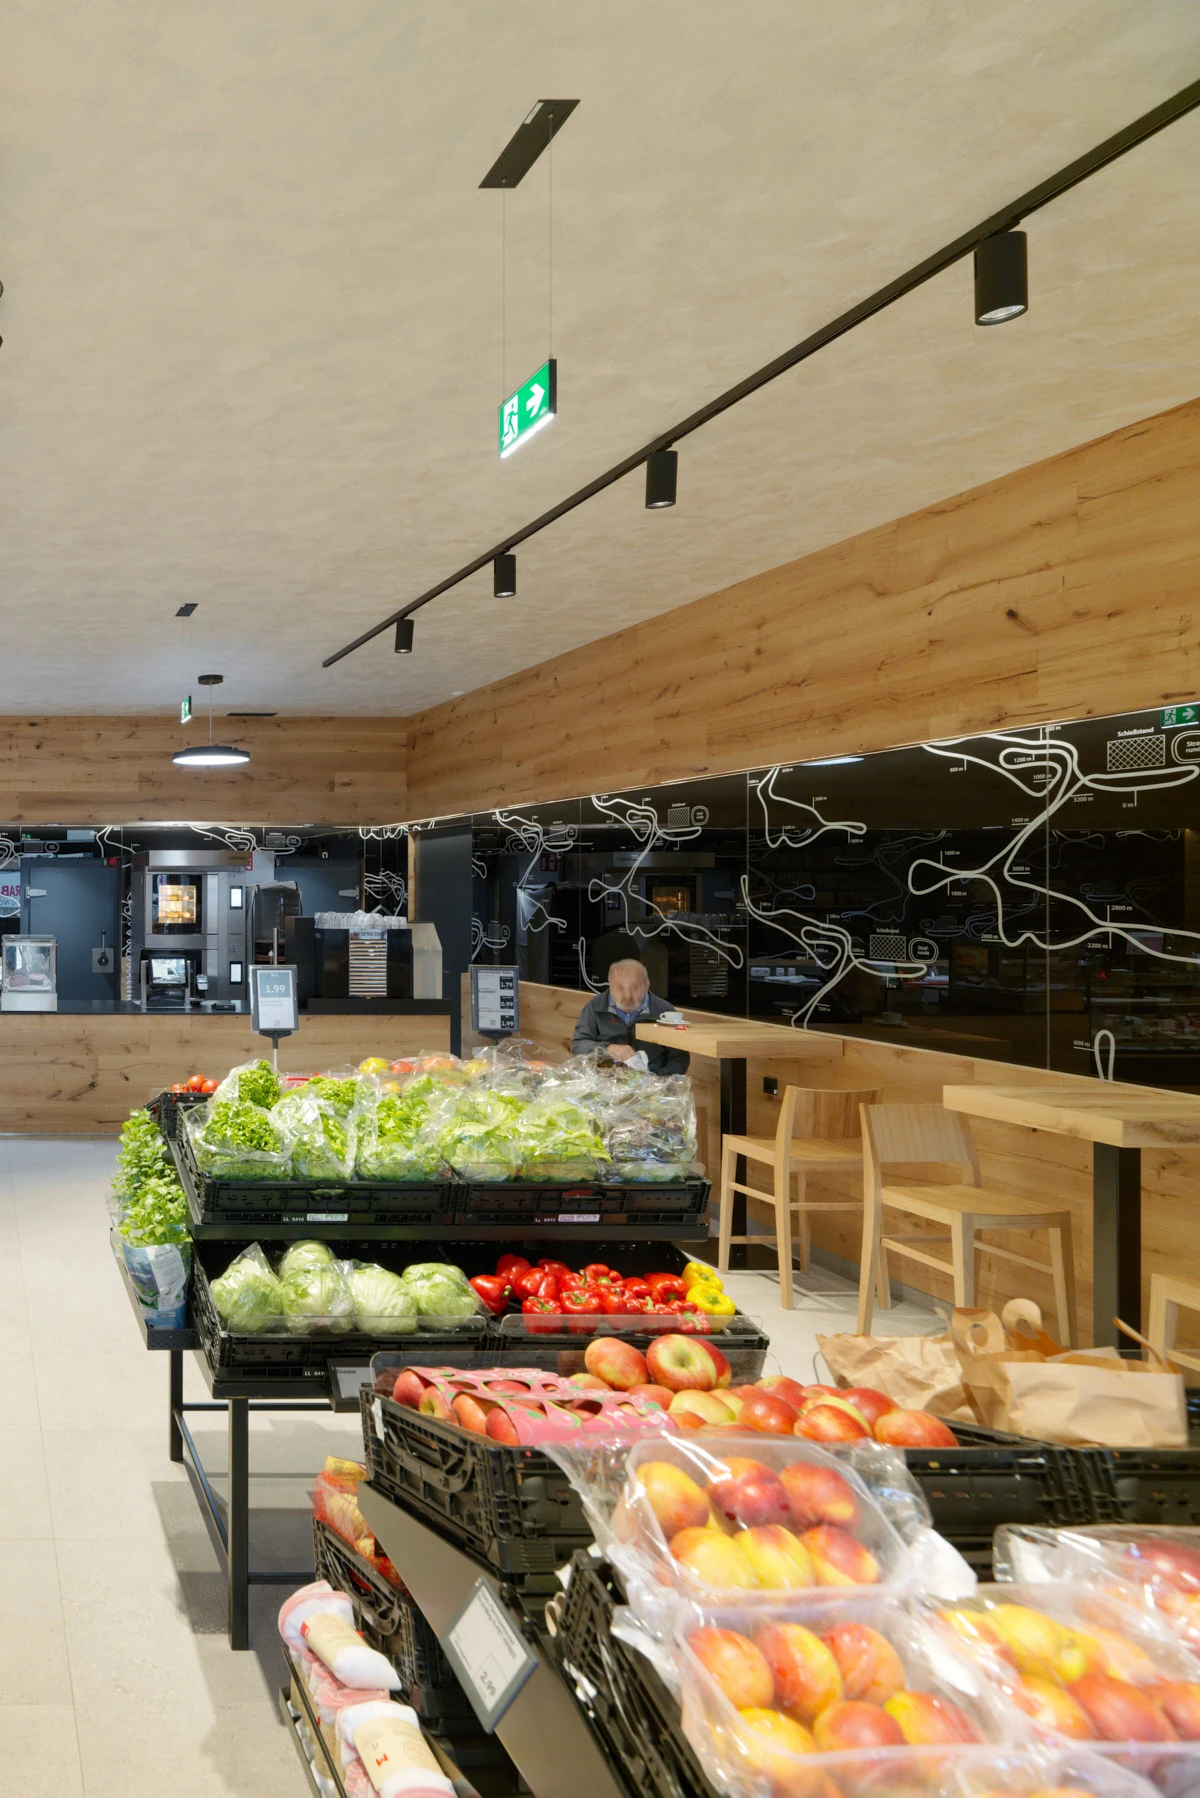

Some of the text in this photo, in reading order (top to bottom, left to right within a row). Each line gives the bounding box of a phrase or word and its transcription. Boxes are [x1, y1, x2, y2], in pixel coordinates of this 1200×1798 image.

[1117, 727, 1154, 737] Schießstand
[265, 984, 286, 993] 1.99
[480, 1671, 496, 1697] 2.99
